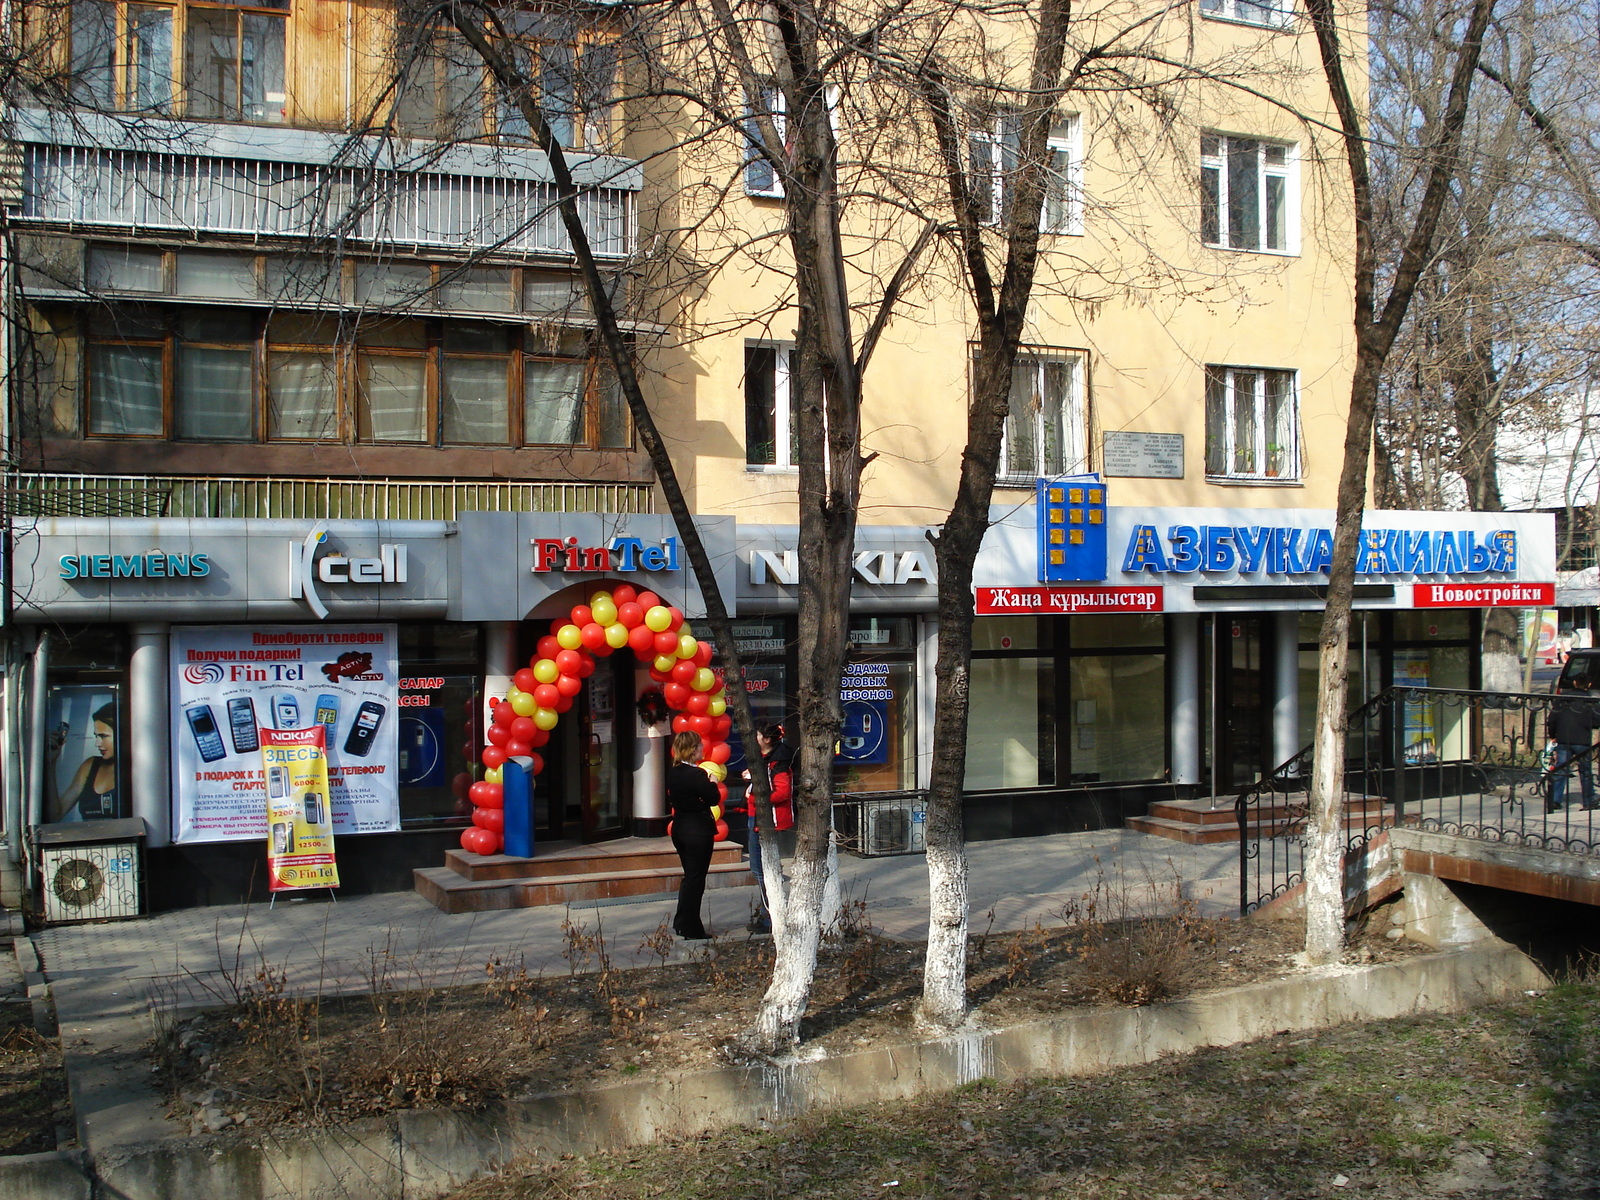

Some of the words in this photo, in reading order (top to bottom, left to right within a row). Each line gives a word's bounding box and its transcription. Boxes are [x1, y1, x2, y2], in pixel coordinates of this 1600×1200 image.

[1121, 524, 1334, 575] АЗБУКА
[1355, 528, 1518, 576] ЖИЛЬЯ
[58, 553, 211, 580] SIEMENS
[288, 520, 408, 620] Kcell
[749, 549, 939, 585] NKIA
[990, 588, 1043, 609] Жаңа
[1049, 591, 1157, 611] құрылыстар
[1430, 584, 1542, 606] Новостройки
[252, 632, 324, 646] Приобрети
[326, 632, 384, 646] телефон
[850, 630, 884, 643] арок!!
[187, 649, 237, 662] Получи
[239, 647, 302, 662] подарки!
[847, 663, 890, 675] ОДАЖА
[399, 678, 445, 690] САЛАР
[841, 676, 888, 687] ОТОВЫХ
[841, 689, 894, 701] ЛЕФОНОВ
[270, 731, 315, 741] NOKIA
[265, 746, 324, 764] ЗДЕСЬ!
[195, 772, 202, 781] В
[204, 771, 246, 782] ПОДАРОК
[247, 770, 254, 780] К
[340, 765, 386, 776] ТЕЛЕФОНУ
[232, 780, 266, 791] СТАРТО
[294, 779, 315, 787] 6800
[272, 809, 294, 818] 7200
[298, 841, 322, 849] 12500
